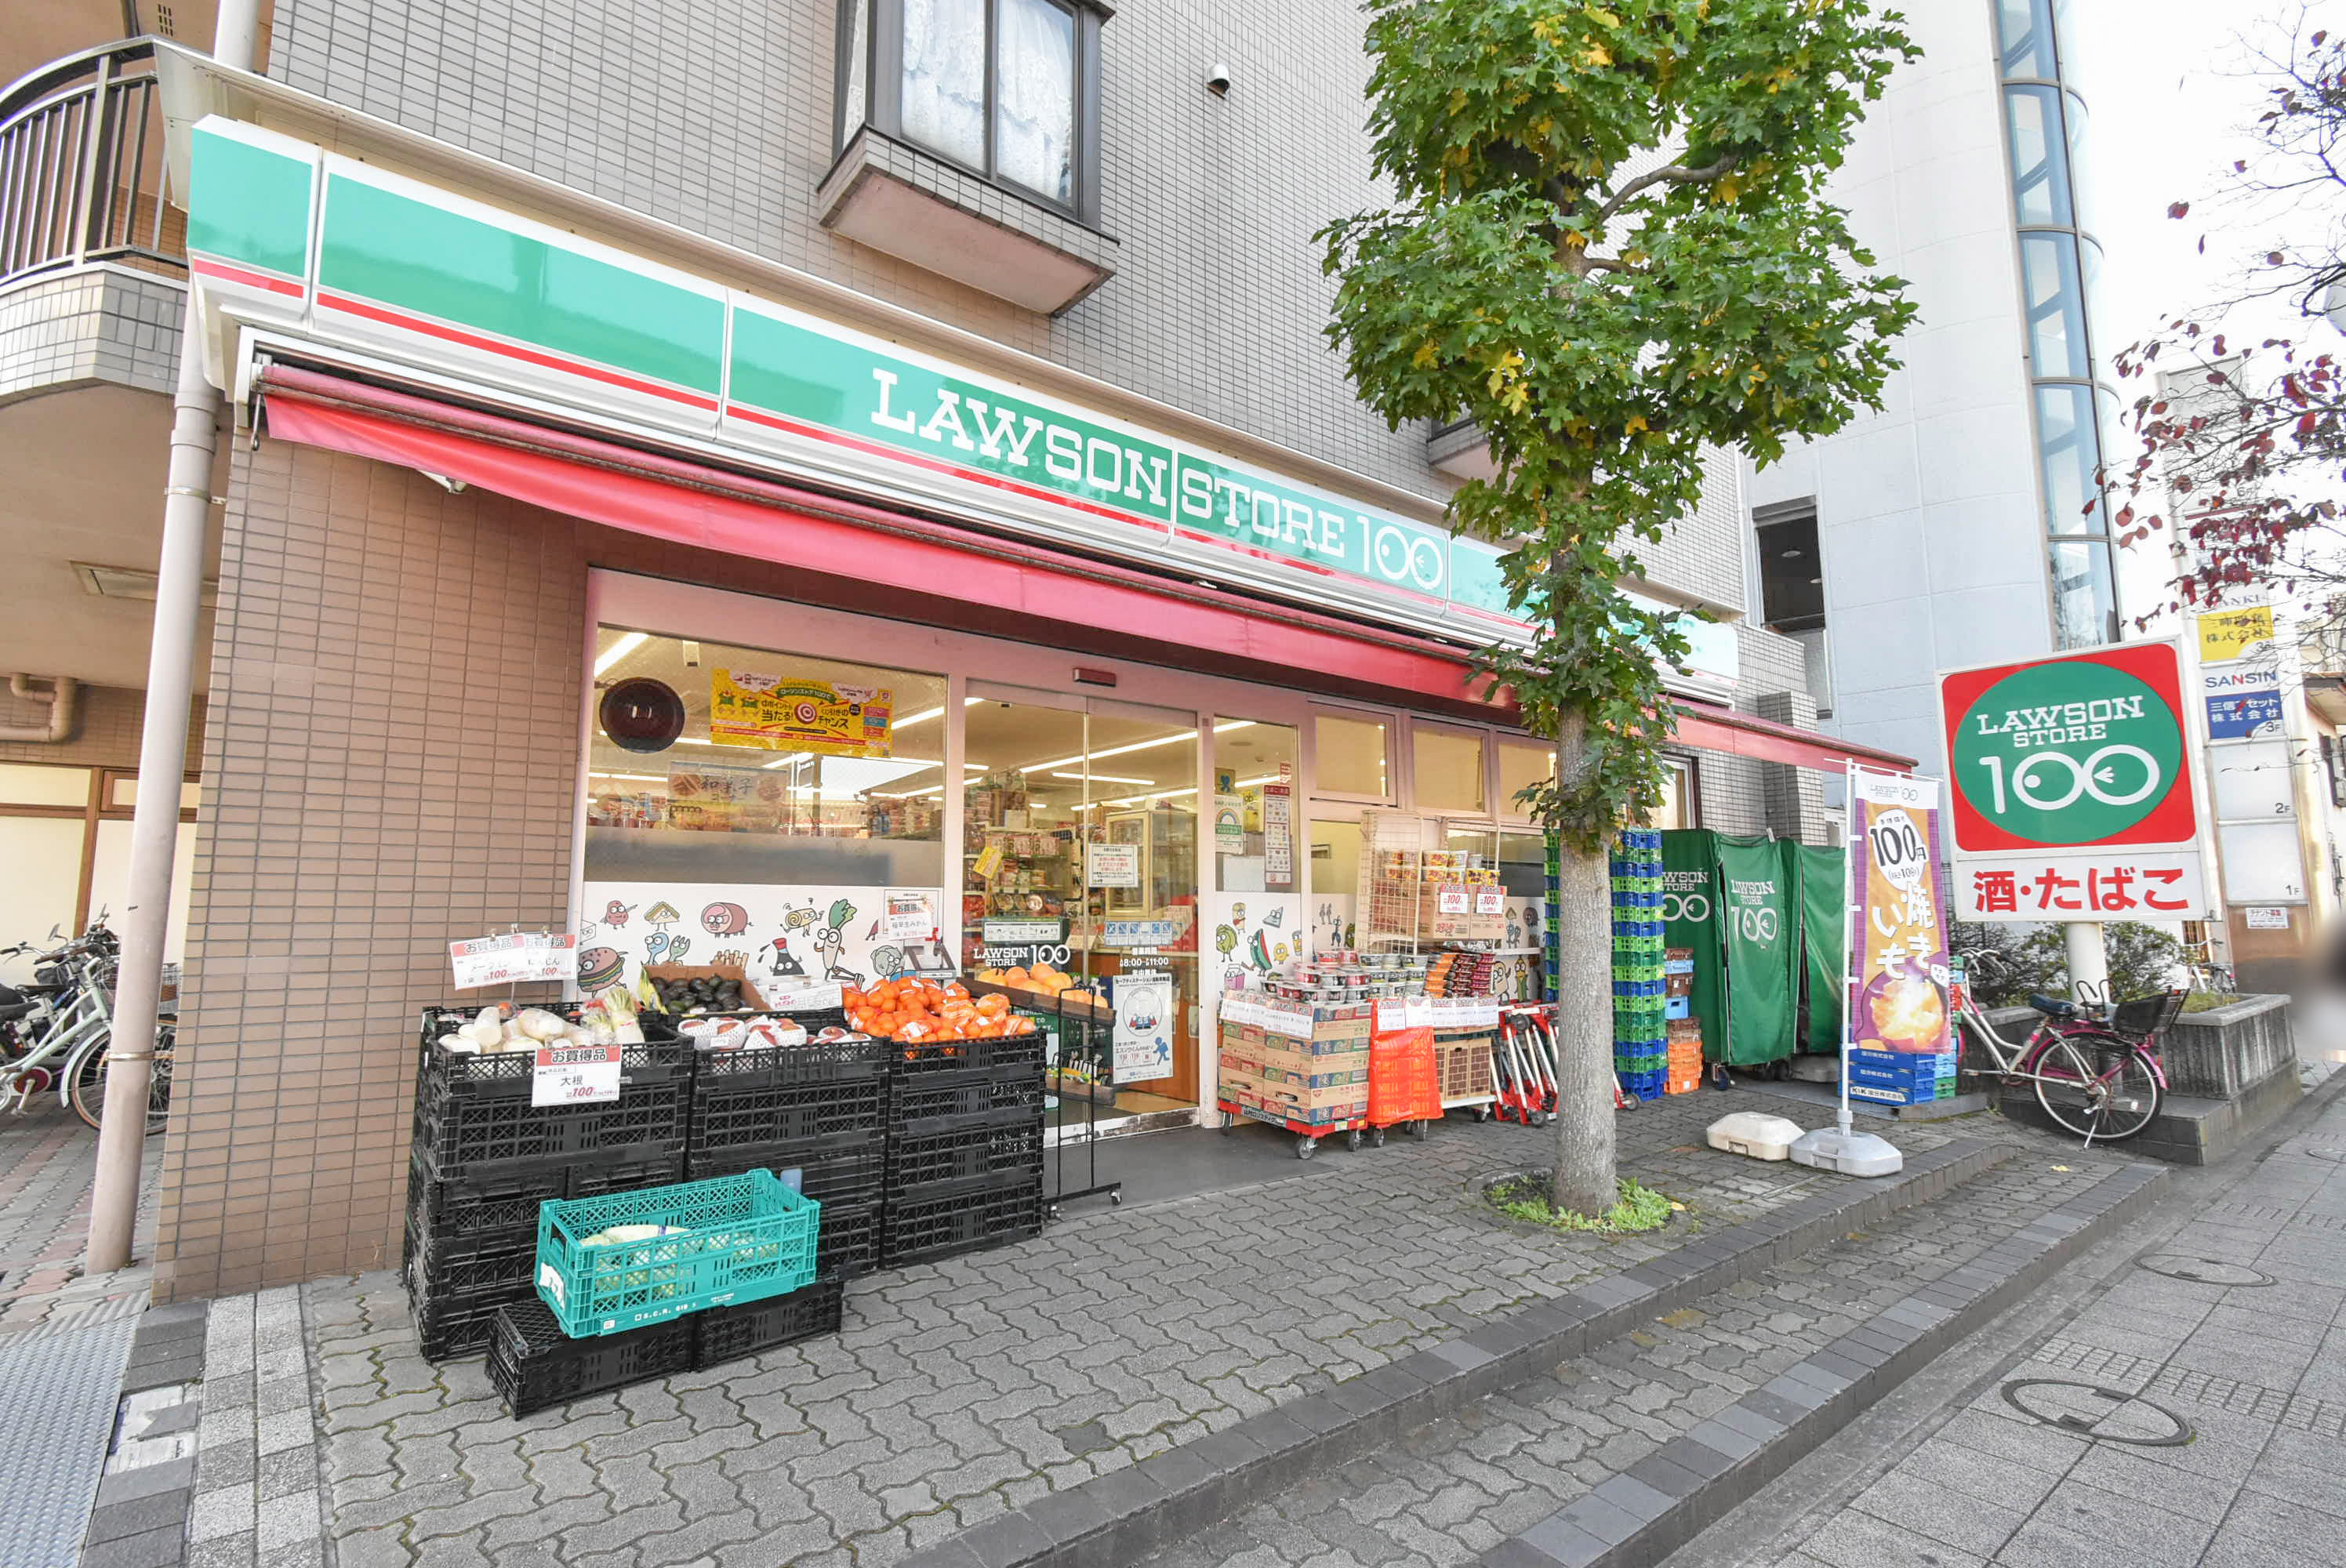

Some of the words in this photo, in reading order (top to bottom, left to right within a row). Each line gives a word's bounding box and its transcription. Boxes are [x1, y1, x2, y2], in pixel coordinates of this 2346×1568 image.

[871, 368, 1167, 506] LAWSON
[1182, 467, 1345, 558] STORE
[1357, 515, 1444, 590] 100
[2205, 672, 2277, 688] SANSIN
[2210, 697, 2279, 712] 三信セット
[1977, 695, 2144, 735] LAWSON
[2212, 708, 2279, 723] 株式会社
[2265, 721, 2281, 732] 3F
[2013, 724, 2107, 747] STORE
[1979, 744, 2160, 815] 100
[2275, 803, 2290, 814] 2F
[1870, 825, 1927, 866] 100円
[1661, 872, 1708, 883] WSON
[2286, 884, 2300, 895] 1F
[1447, 895, 1461, 903] 100
[1484, 895, 1497, 905] 100
[1662, 894, 1710, 922] 00
[1730, 906, 1777, 942] 100
[1901, 882, 1935, 971] 焼き
[1872, 905, 1906, 980] いも
[973, 947, 1028, 959] LAWSON
[1031, 945, 1071, 965] 100
[489, 969, 508, 979] 100
[541, 967, 557, 975] 100
[552, 1048, 607, 1063] お買得品
[560, 1075, 583, 1087] 大根
[572, 1086, 595, 1098] 100
